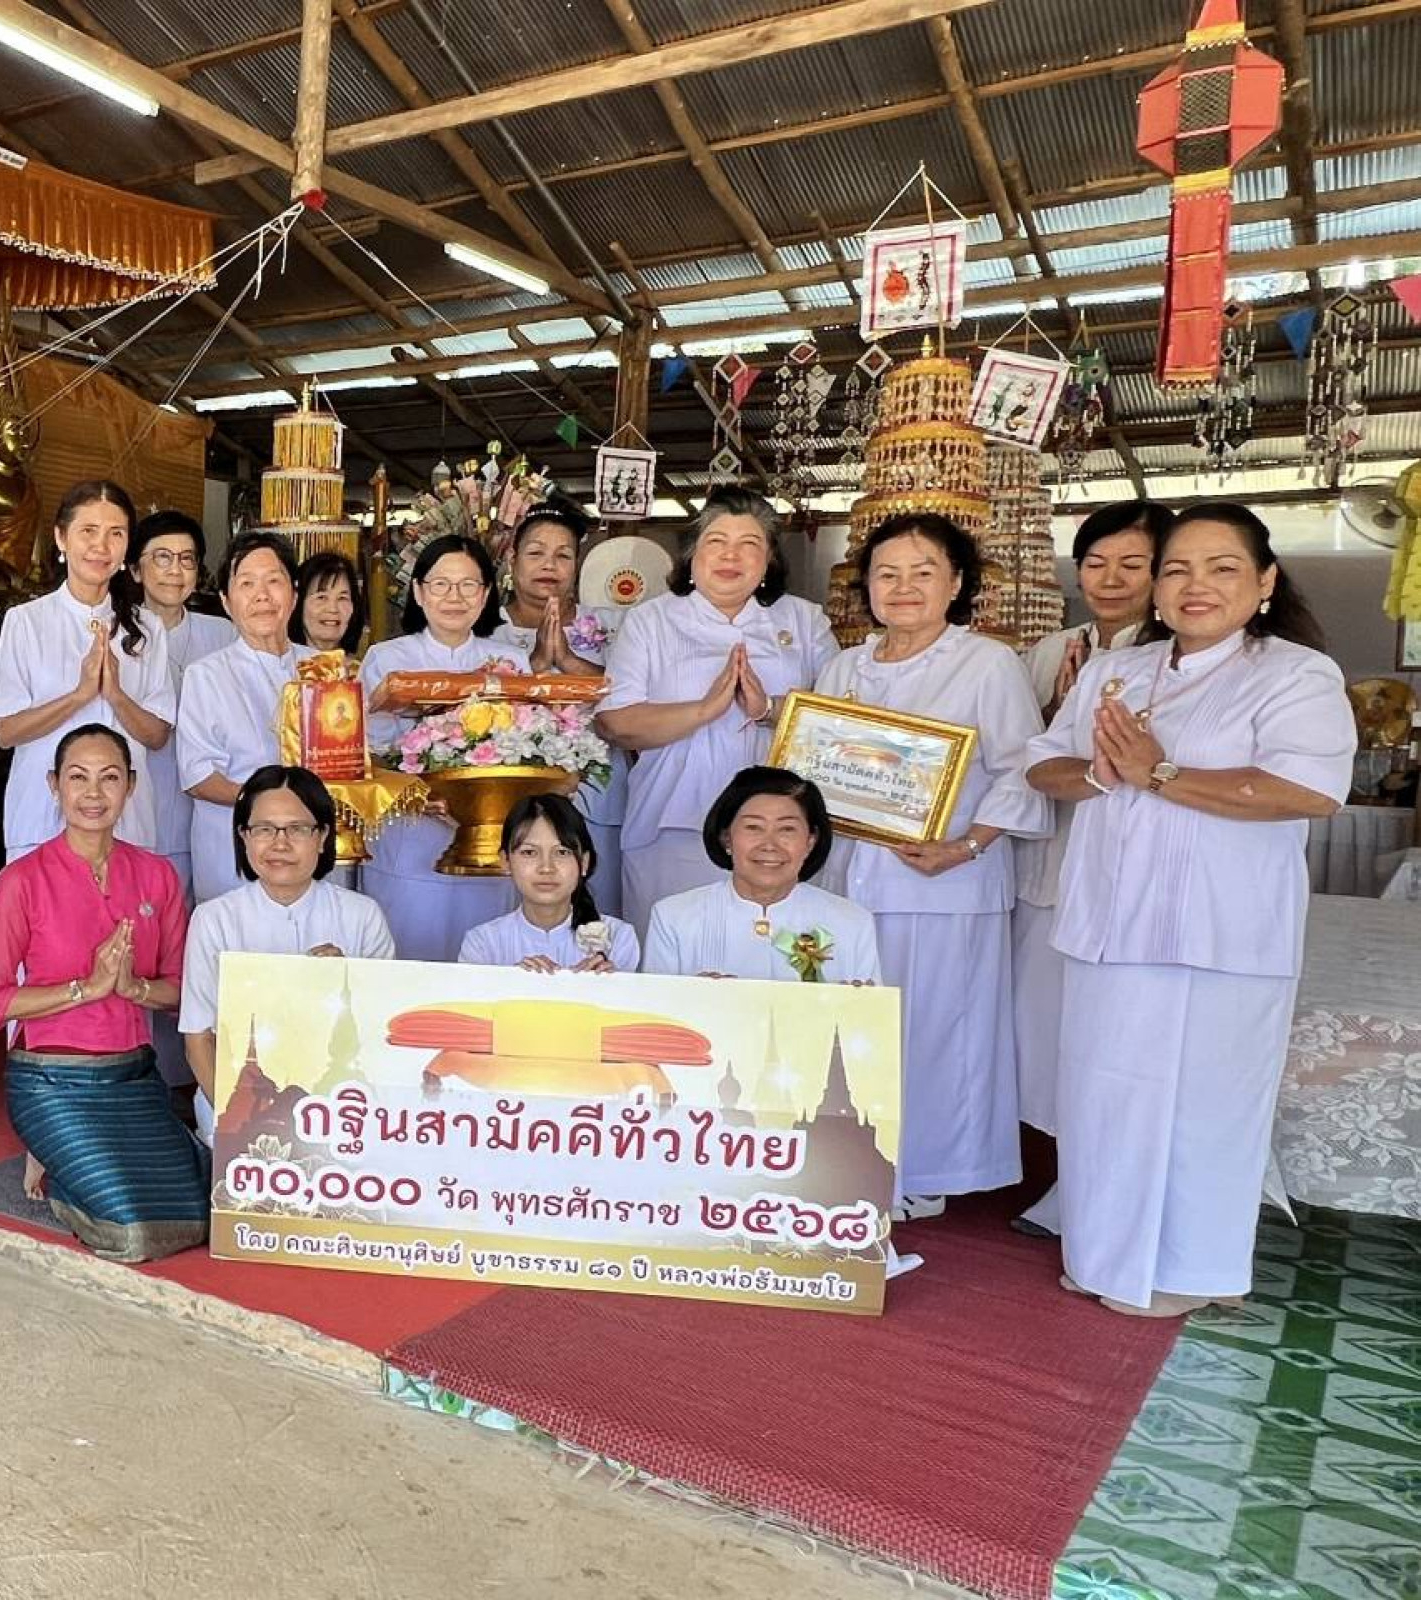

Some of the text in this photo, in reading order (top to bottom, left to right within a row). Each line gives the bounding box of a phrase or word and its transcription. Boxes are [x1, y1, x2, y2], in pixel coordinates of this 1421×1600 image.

[300, 1087, 798, 1171] กฐินสามัคคีทั่วไทย
[233, 1164, 869, 1242] ๓๐,๐๐๐ วัด พุทธศักราช ๒๕๖๘
[237, 1226, 277, 1249] โดย
[285, 1233, 462, 1268] คณะศิษยานุศิษย์
[588, 1261, 622, 1278] ๘๑
[632, 1258, 648, 1279] ปี
[658, 1266, 853, 1298] หลวงพ่อธัมมชโย
